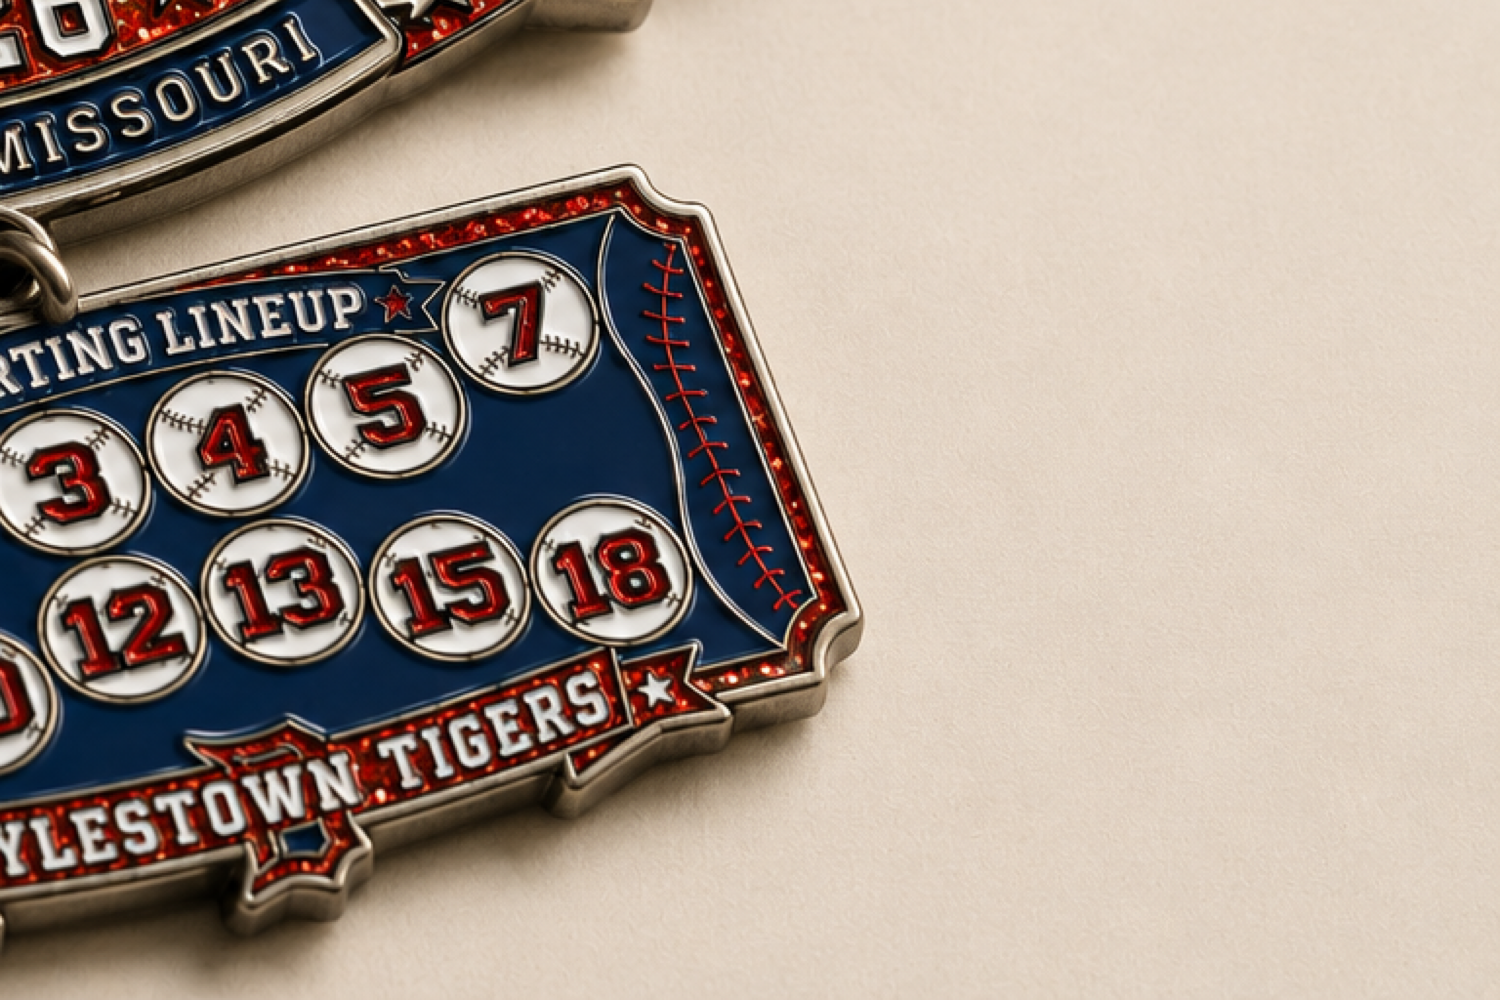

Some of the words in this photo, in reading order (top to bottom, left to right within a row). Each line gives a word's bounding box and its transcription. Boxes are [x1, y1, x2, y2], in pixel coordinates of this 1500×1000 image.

[156, 285, 364, 355] LINEUP
[27, 441, 113, 526] 3
[197, 403, 269, 487] 4
[342, 362, 427, 447] 5
[480, 278, 545, 368] 7
[60, 584, 187, 681] 12
[225, 549, 346, 642] 13
[394, 541, 510, 639] 15
[551, 528, 673, 623] 18
[378, 670, 609, 790] TIGERS
